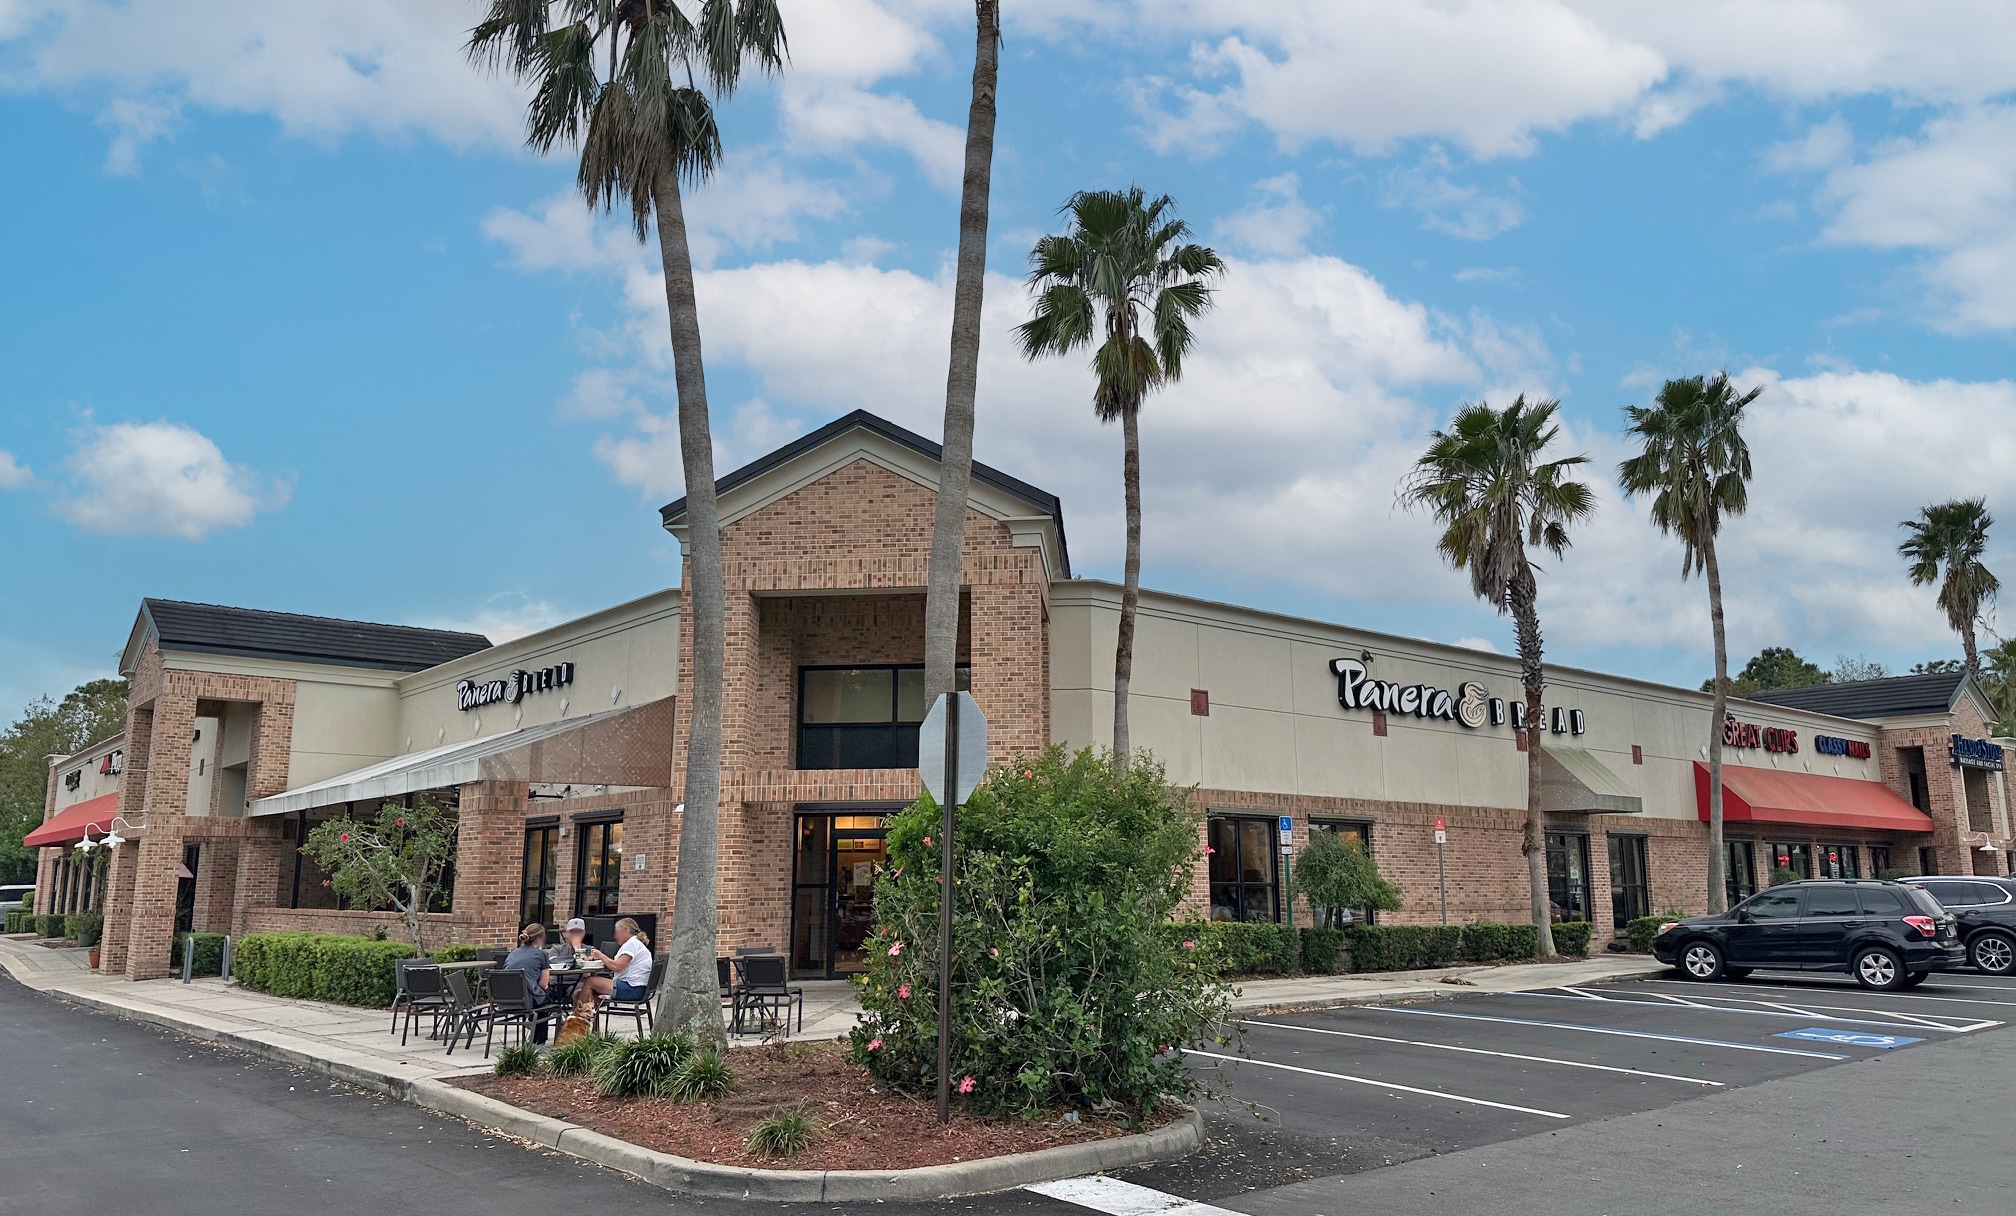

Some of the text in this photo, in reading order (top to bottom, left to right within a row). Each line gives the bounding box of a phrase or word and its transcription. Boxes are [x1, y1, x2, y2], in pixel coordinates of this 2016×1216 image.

[457, 680, 506, 711] Panera
[1329, 658, 1585, 735] Panera BREAD
[1722, 719, 1799, 754] GREAT CLIPS
[1815, 734, 1871, 759] CLASSY NAILS
